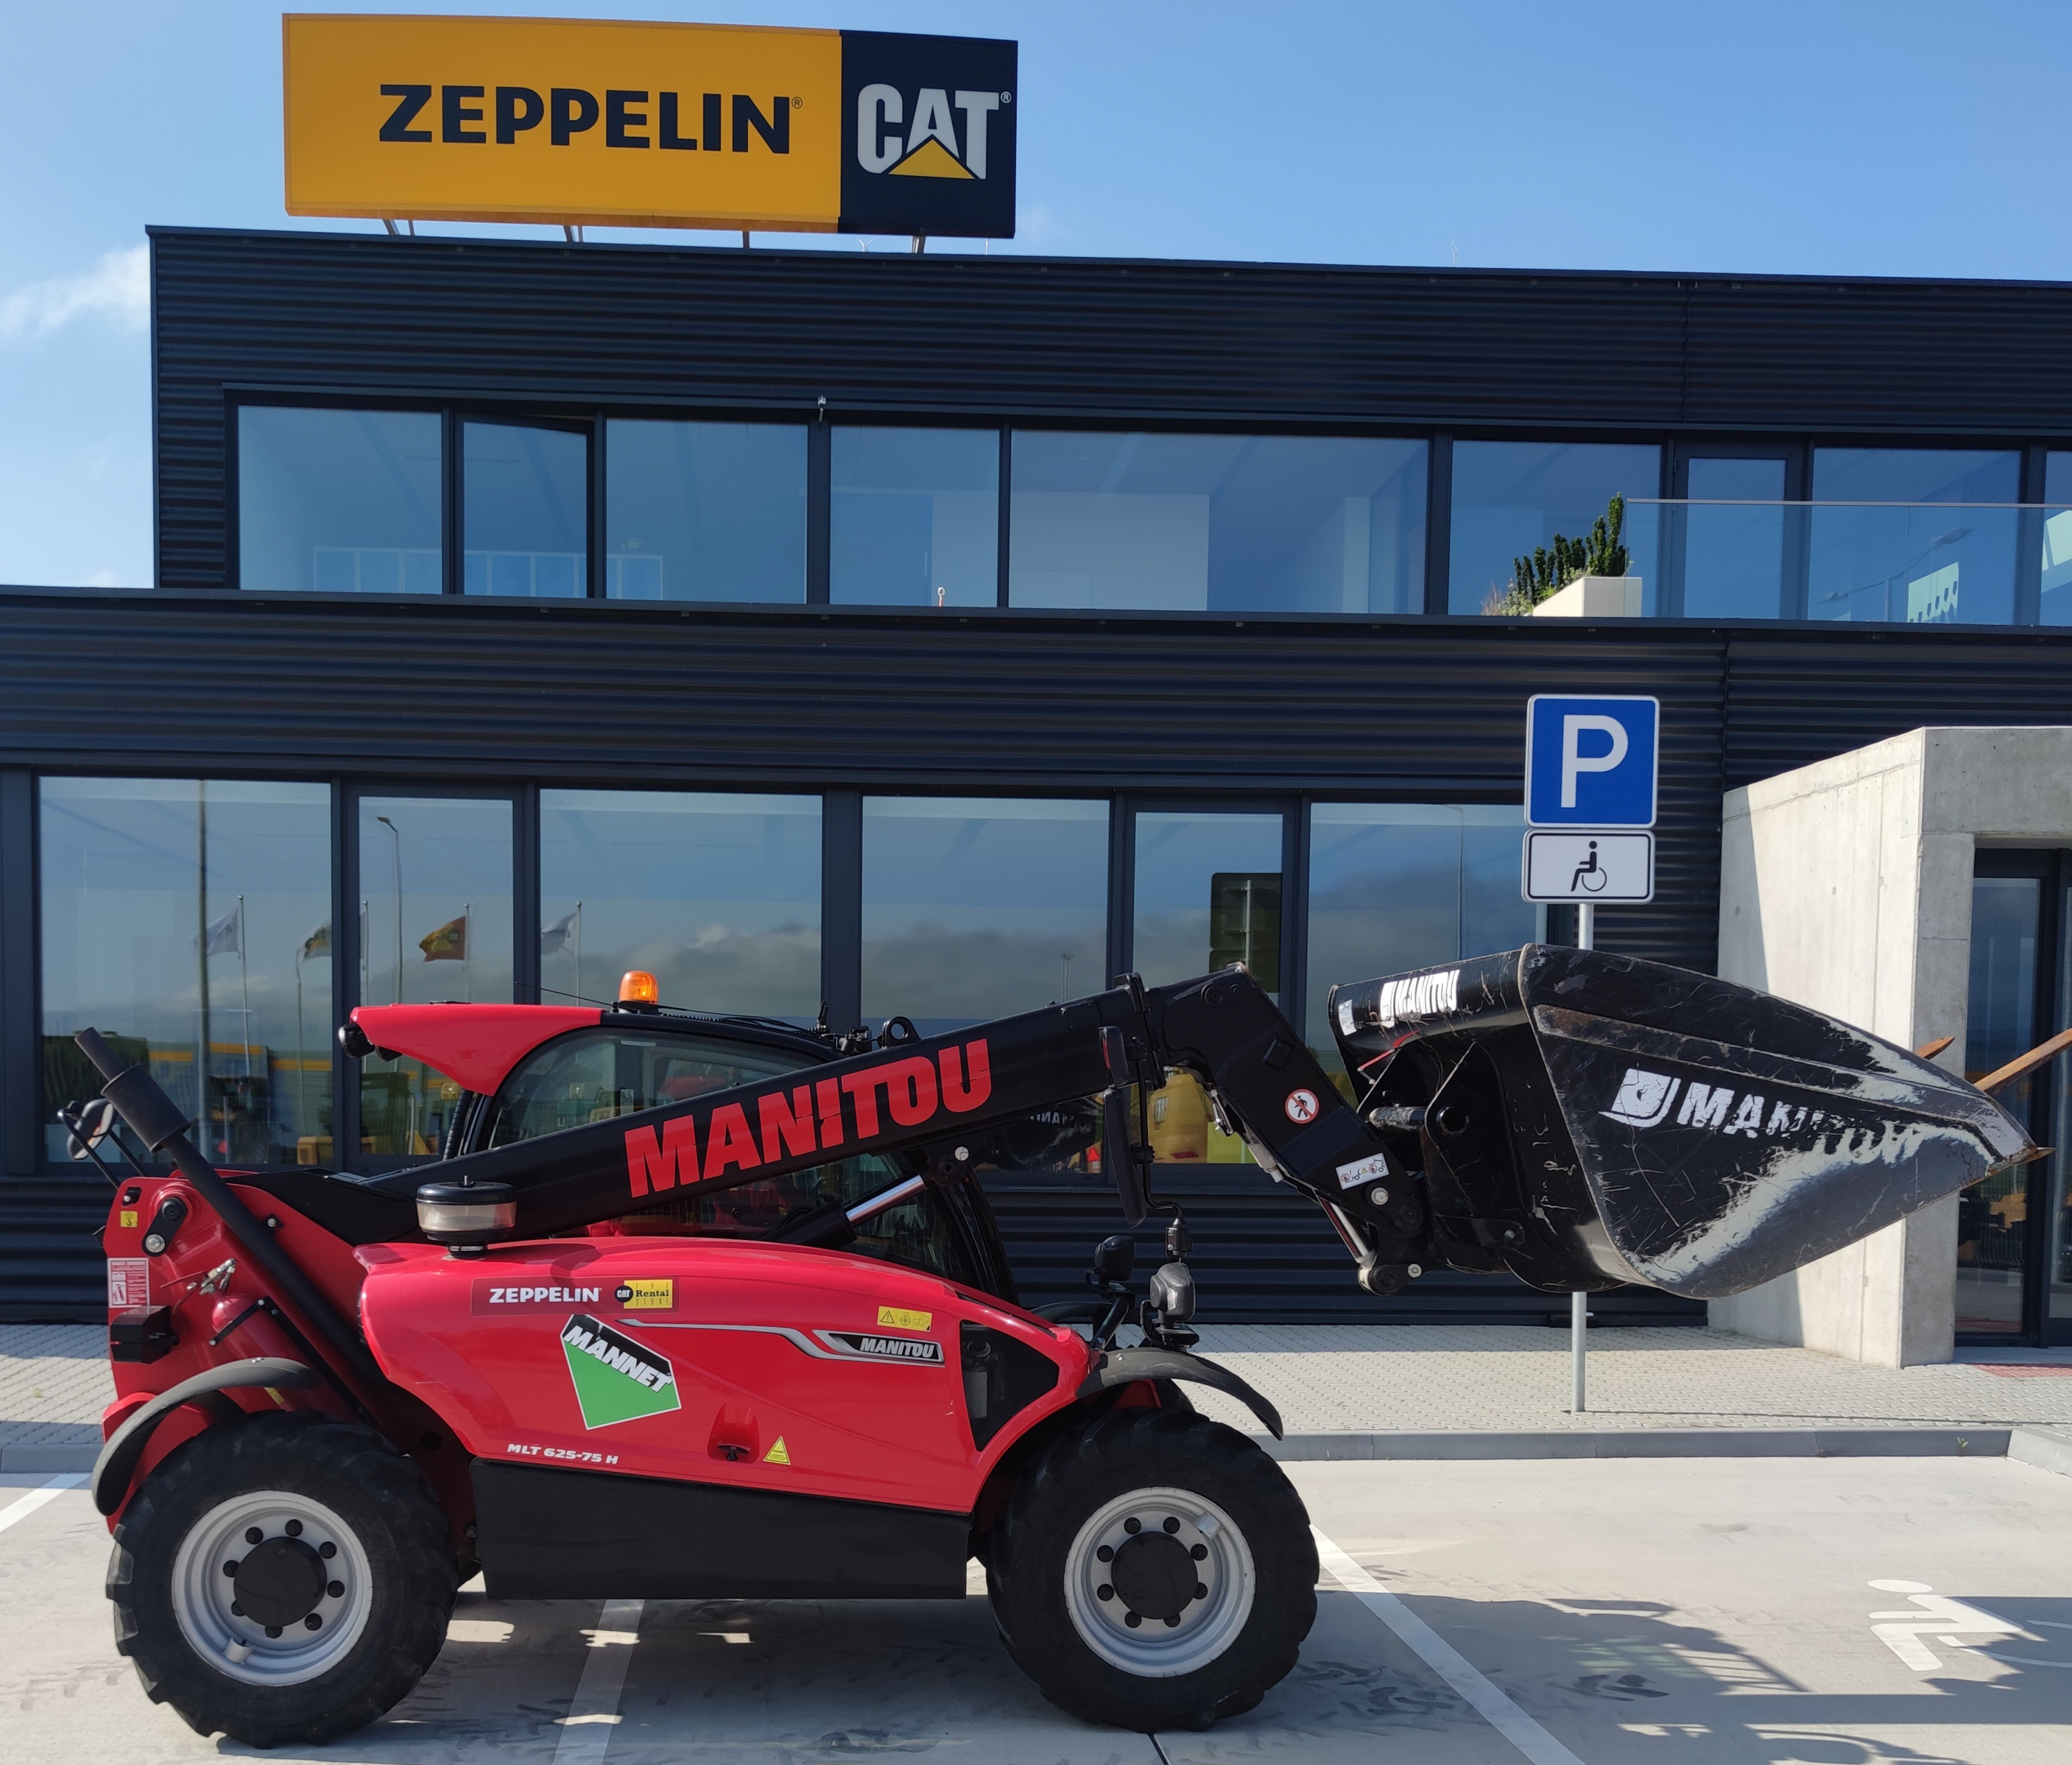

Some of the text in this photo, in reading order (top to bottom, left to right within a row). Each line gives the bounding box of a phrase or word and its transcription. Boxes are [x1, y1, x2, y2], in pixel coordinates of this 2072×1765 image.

[1561, 714, 1629, 808] P
[624, 1038, 992, 1199] MANITOU
[617, 1289, 631, 1298] CAT
[635, 1289, 669, 1297] Rental
[860, 1337, 934, 1358] MANITOU
[563, 1325, 673, 1393] MANNET
[507, 1443, 619, 1465] MLT 625-75 H
